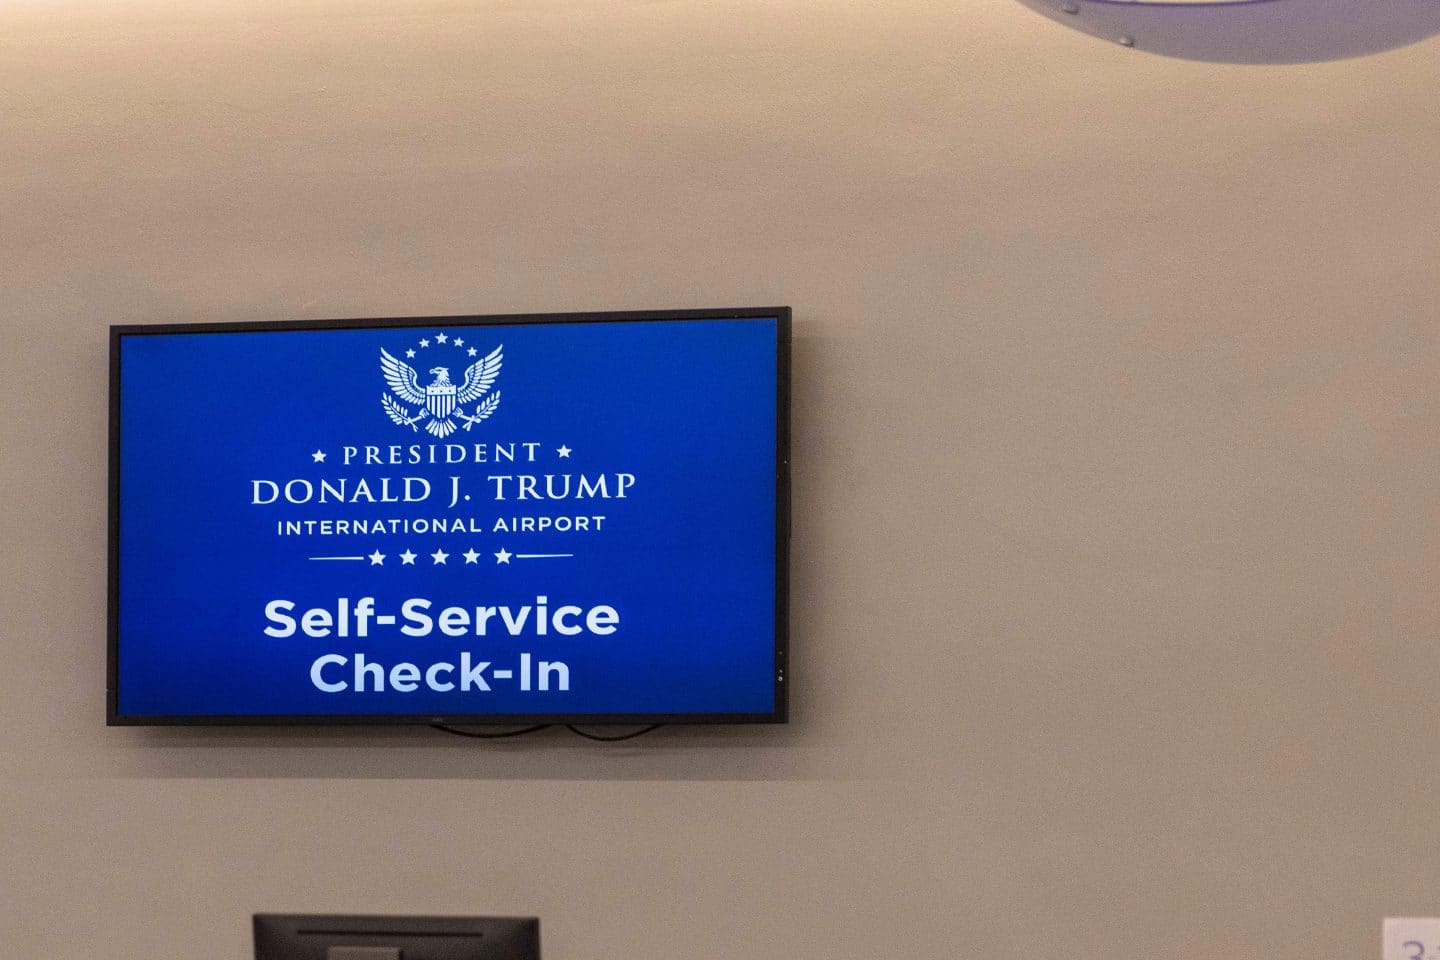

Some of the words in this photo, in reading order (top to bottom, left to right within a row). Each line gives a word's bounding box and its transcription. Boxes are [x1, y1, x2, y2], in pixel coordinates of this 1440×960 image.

[343, 442, 541, 465] PRESIDENT
[251, 477, 431, 505] DONALD
[448, 476, 471, 508] J.
[487, 473, 636, 500] TRUMP
[278, 517, 482, 536] INTERNATIONAL
[492, 515, 606, 533] AIRPORT
[263, 595, 620, 638] Self-Service
[310, 651, 570, 693] Check-In
